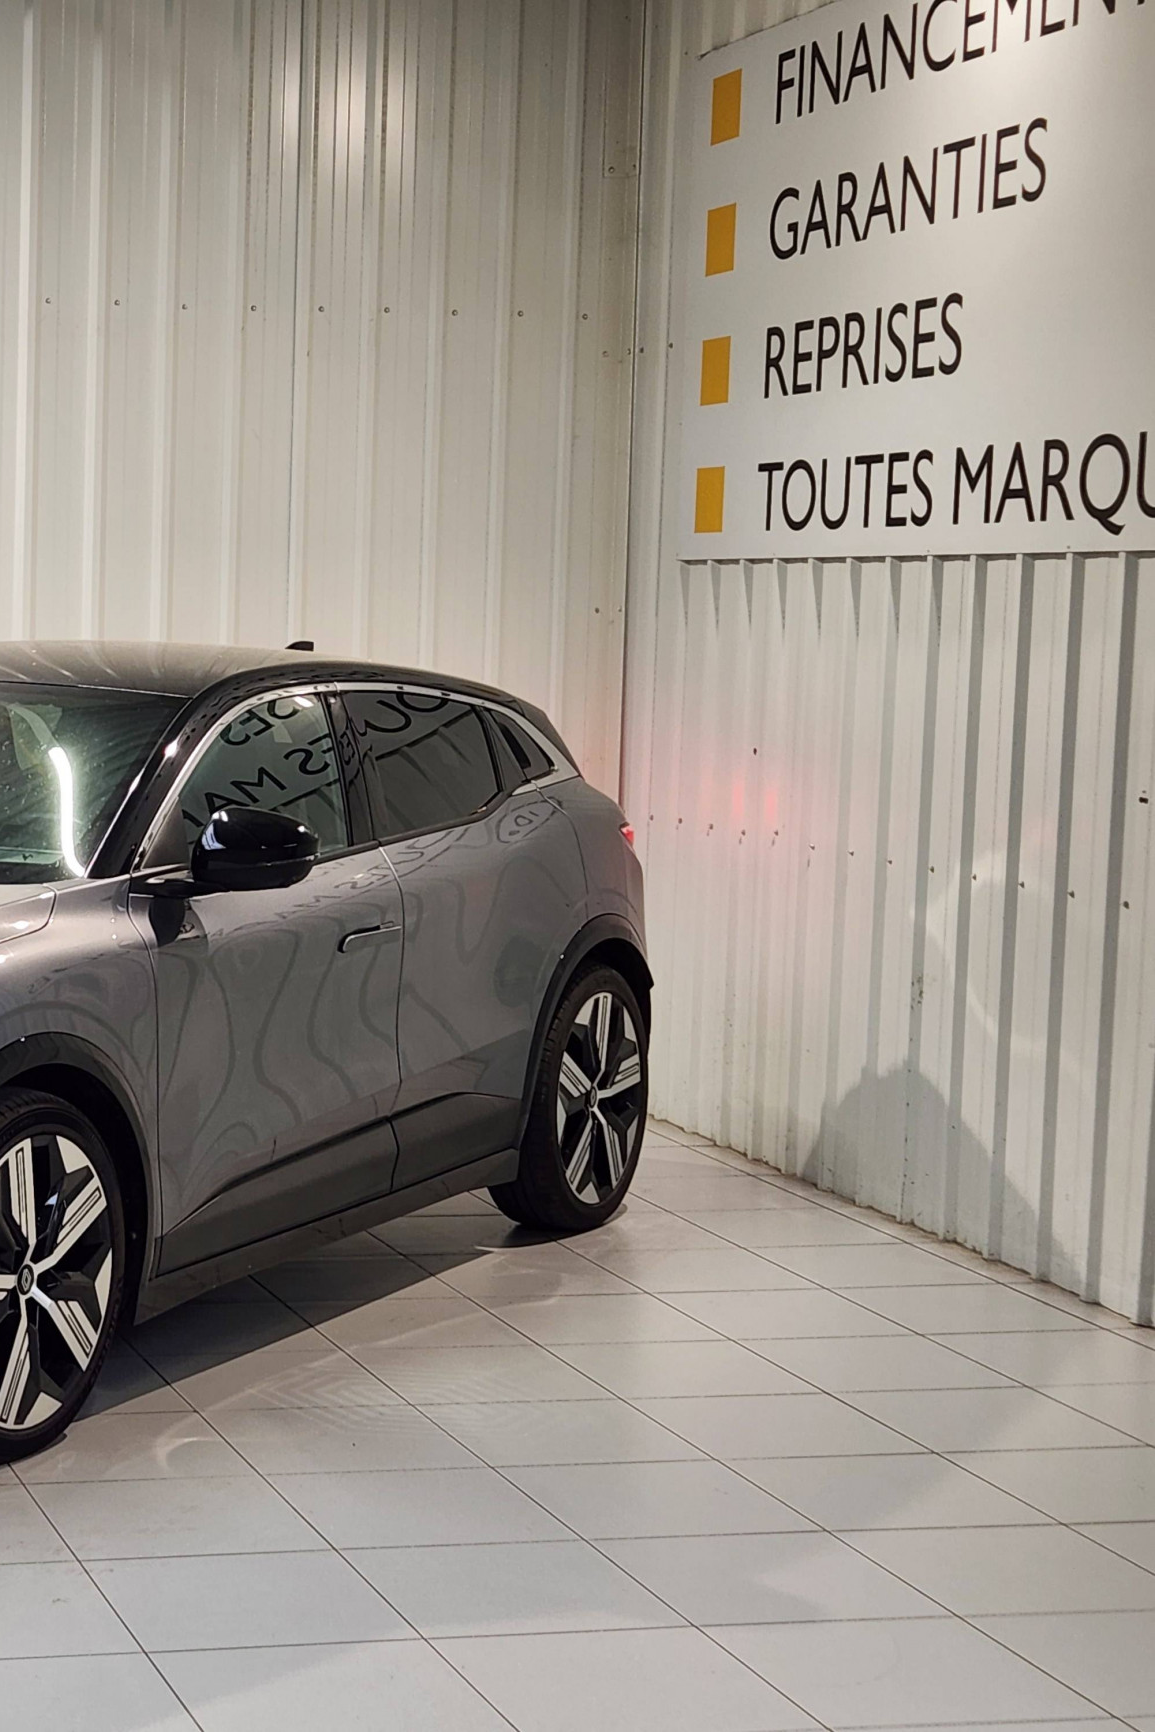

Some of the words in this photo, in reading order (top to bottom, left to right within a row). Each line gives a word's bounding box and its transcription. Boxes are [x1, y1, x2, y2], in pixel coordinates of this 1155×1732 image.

[769, 117, 1049, 260] GARANTIES
[763, 292, 964, 399] REPRISES
[757, 449, 935, 532] TOUTES
